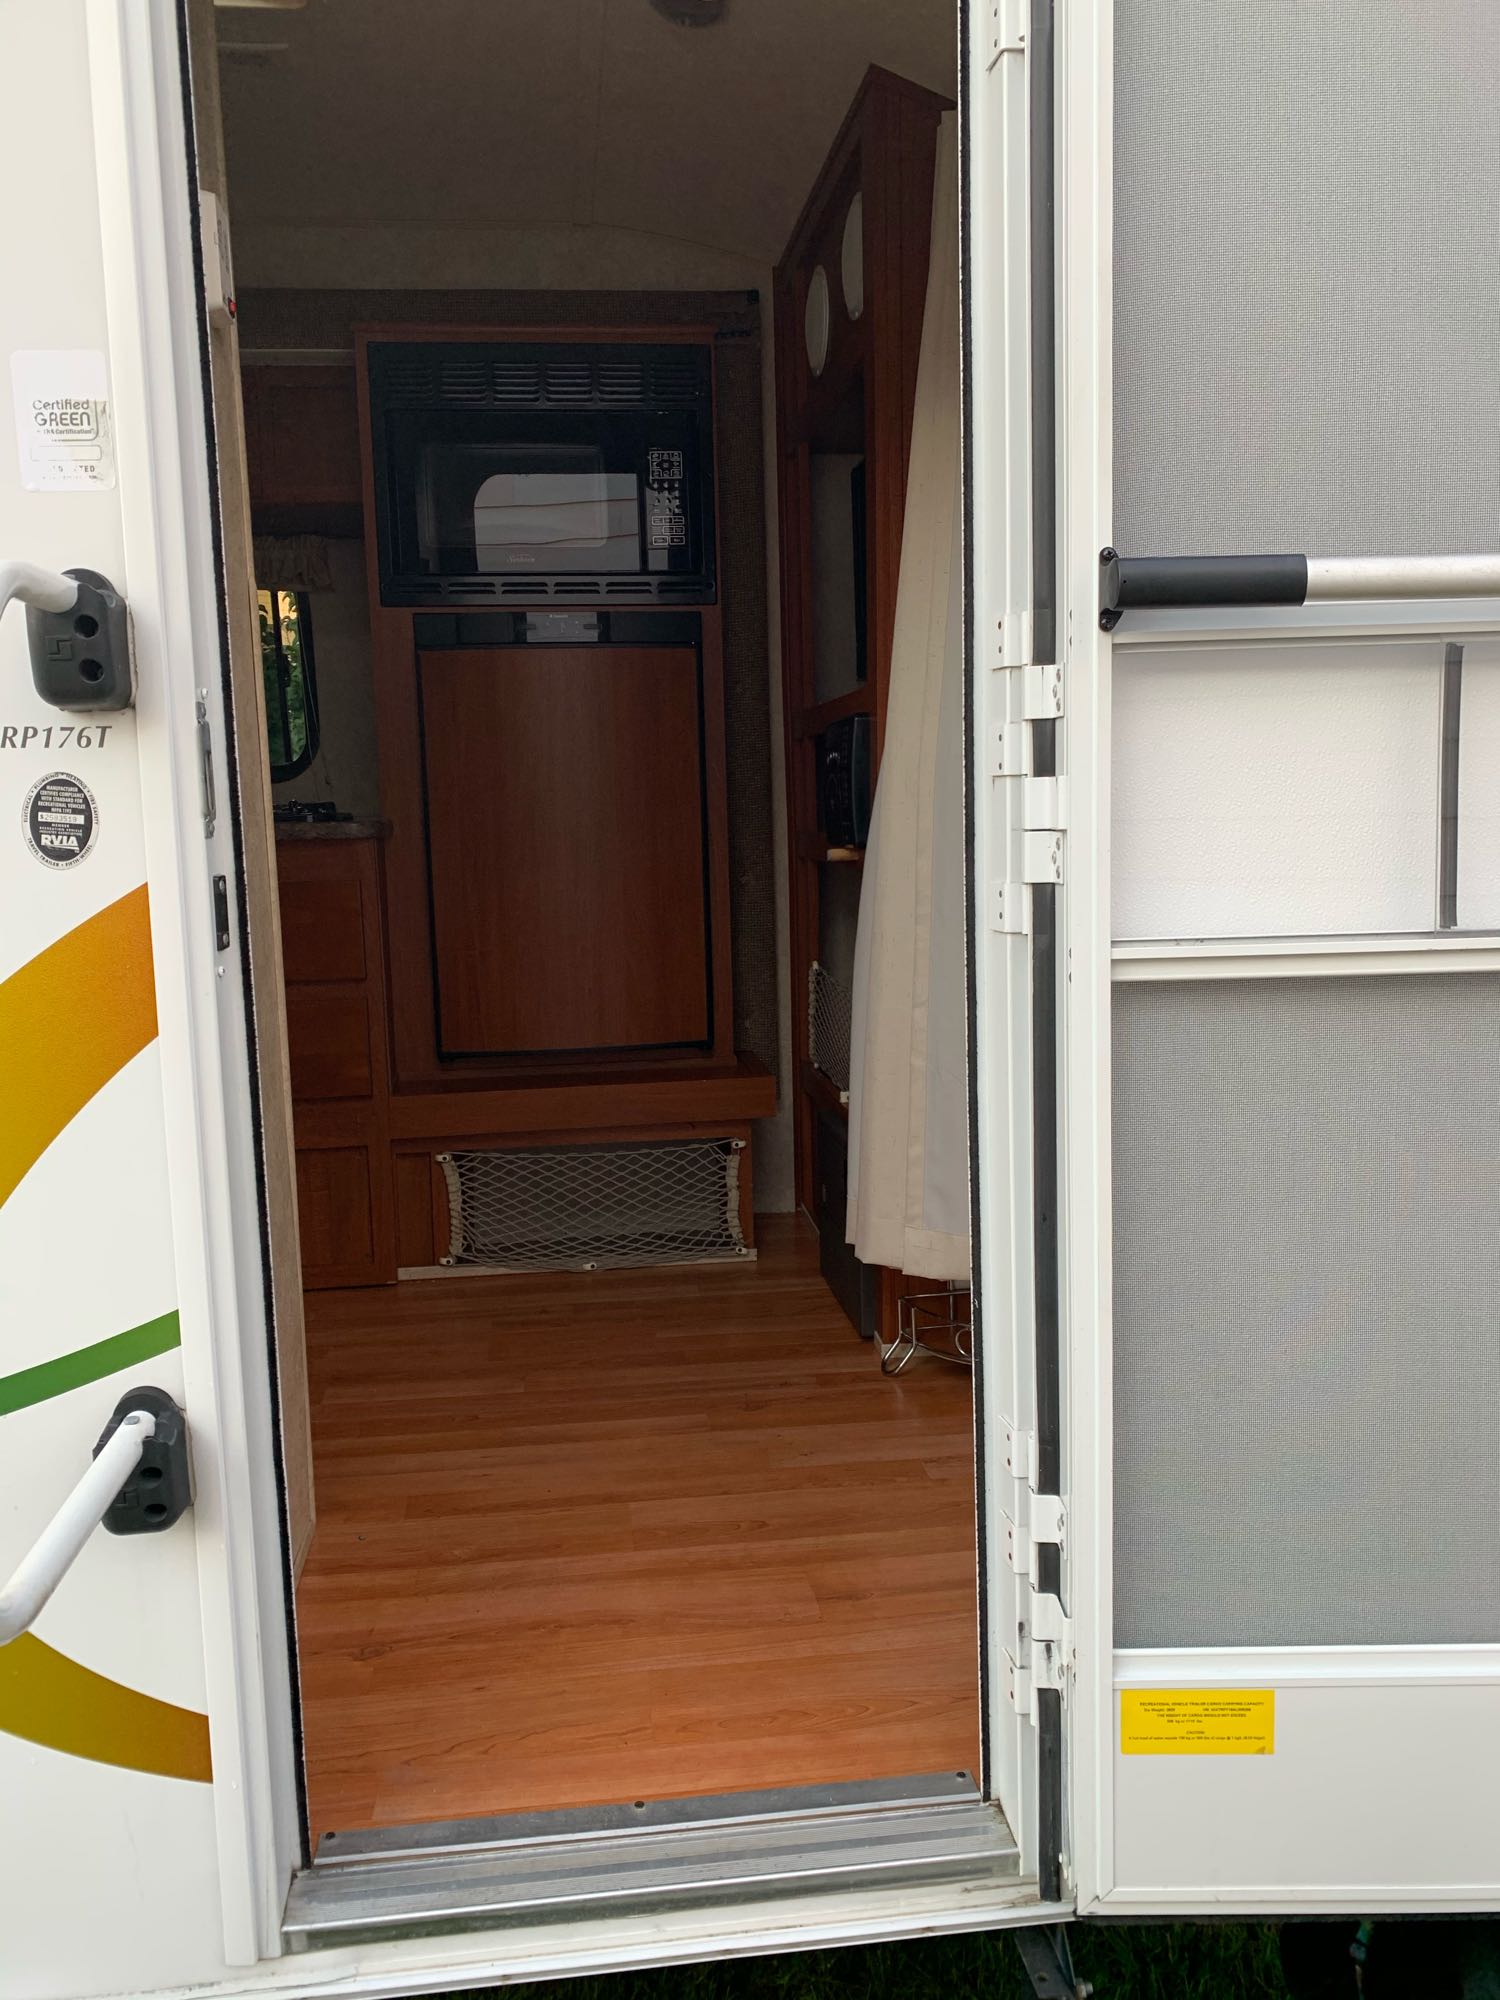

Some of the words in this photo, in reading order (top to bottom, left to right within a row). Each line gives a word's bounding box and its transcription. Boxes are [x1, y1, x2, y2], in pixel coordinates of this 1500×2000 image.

[32, 399, 90, 411] Certified
[34, 412, 91, 427] GREEN
[0, 726, 113, 749] RP176T
[41, 834, 79, 847] RVIA
